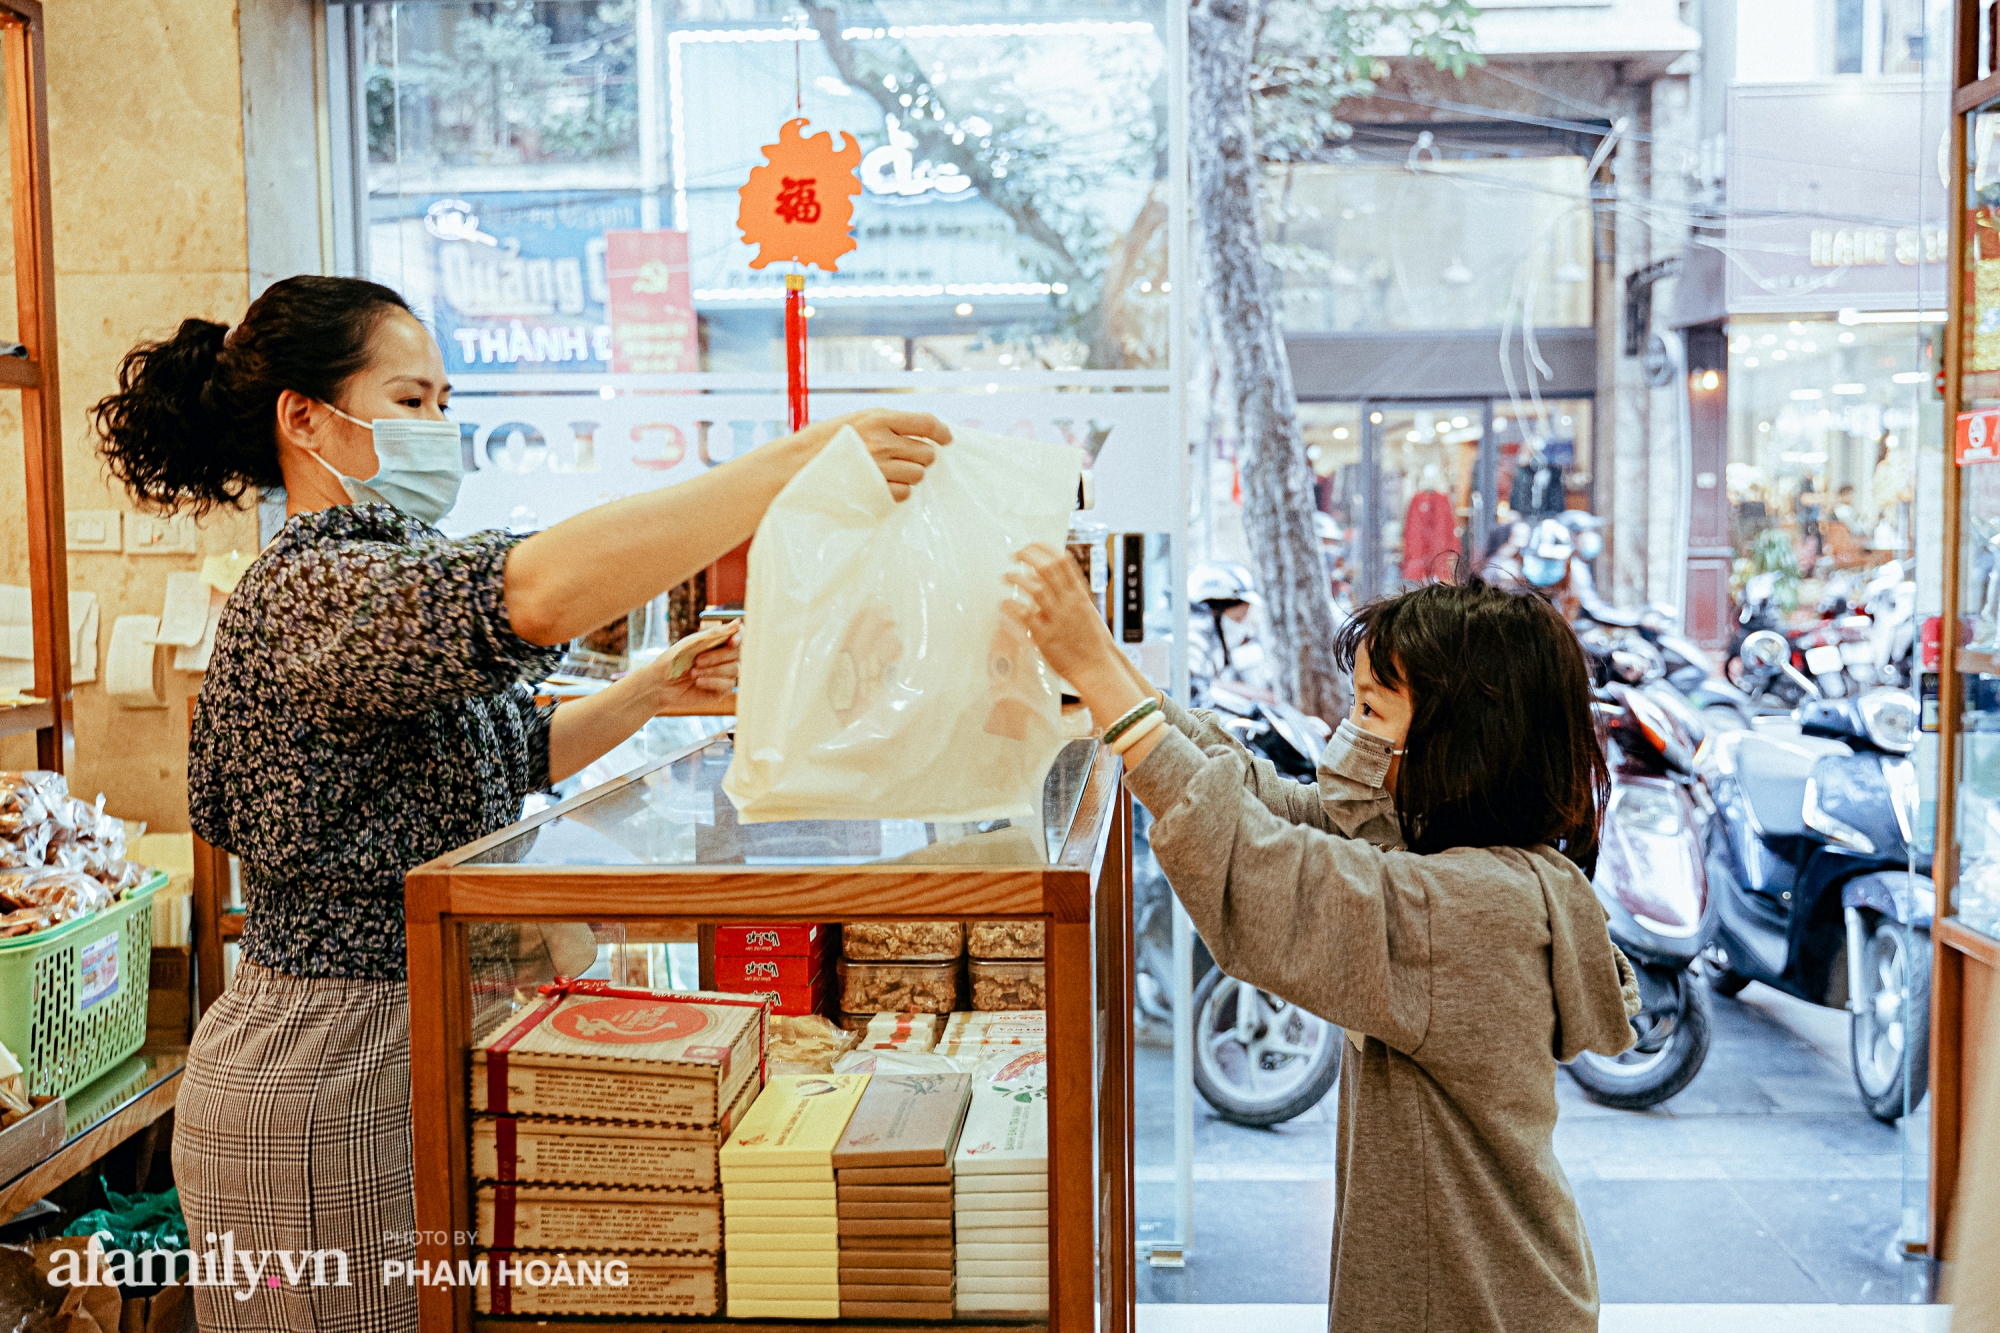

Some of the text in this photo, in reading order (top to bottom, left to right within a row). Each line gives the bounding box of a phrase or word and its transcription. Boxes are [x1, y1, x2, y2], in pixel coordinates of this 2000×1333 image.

[774, 175, 821, 225] 福
[453, 319, 588, 363] THÀNH
[1127, 563, 1138, 612] PUSH
